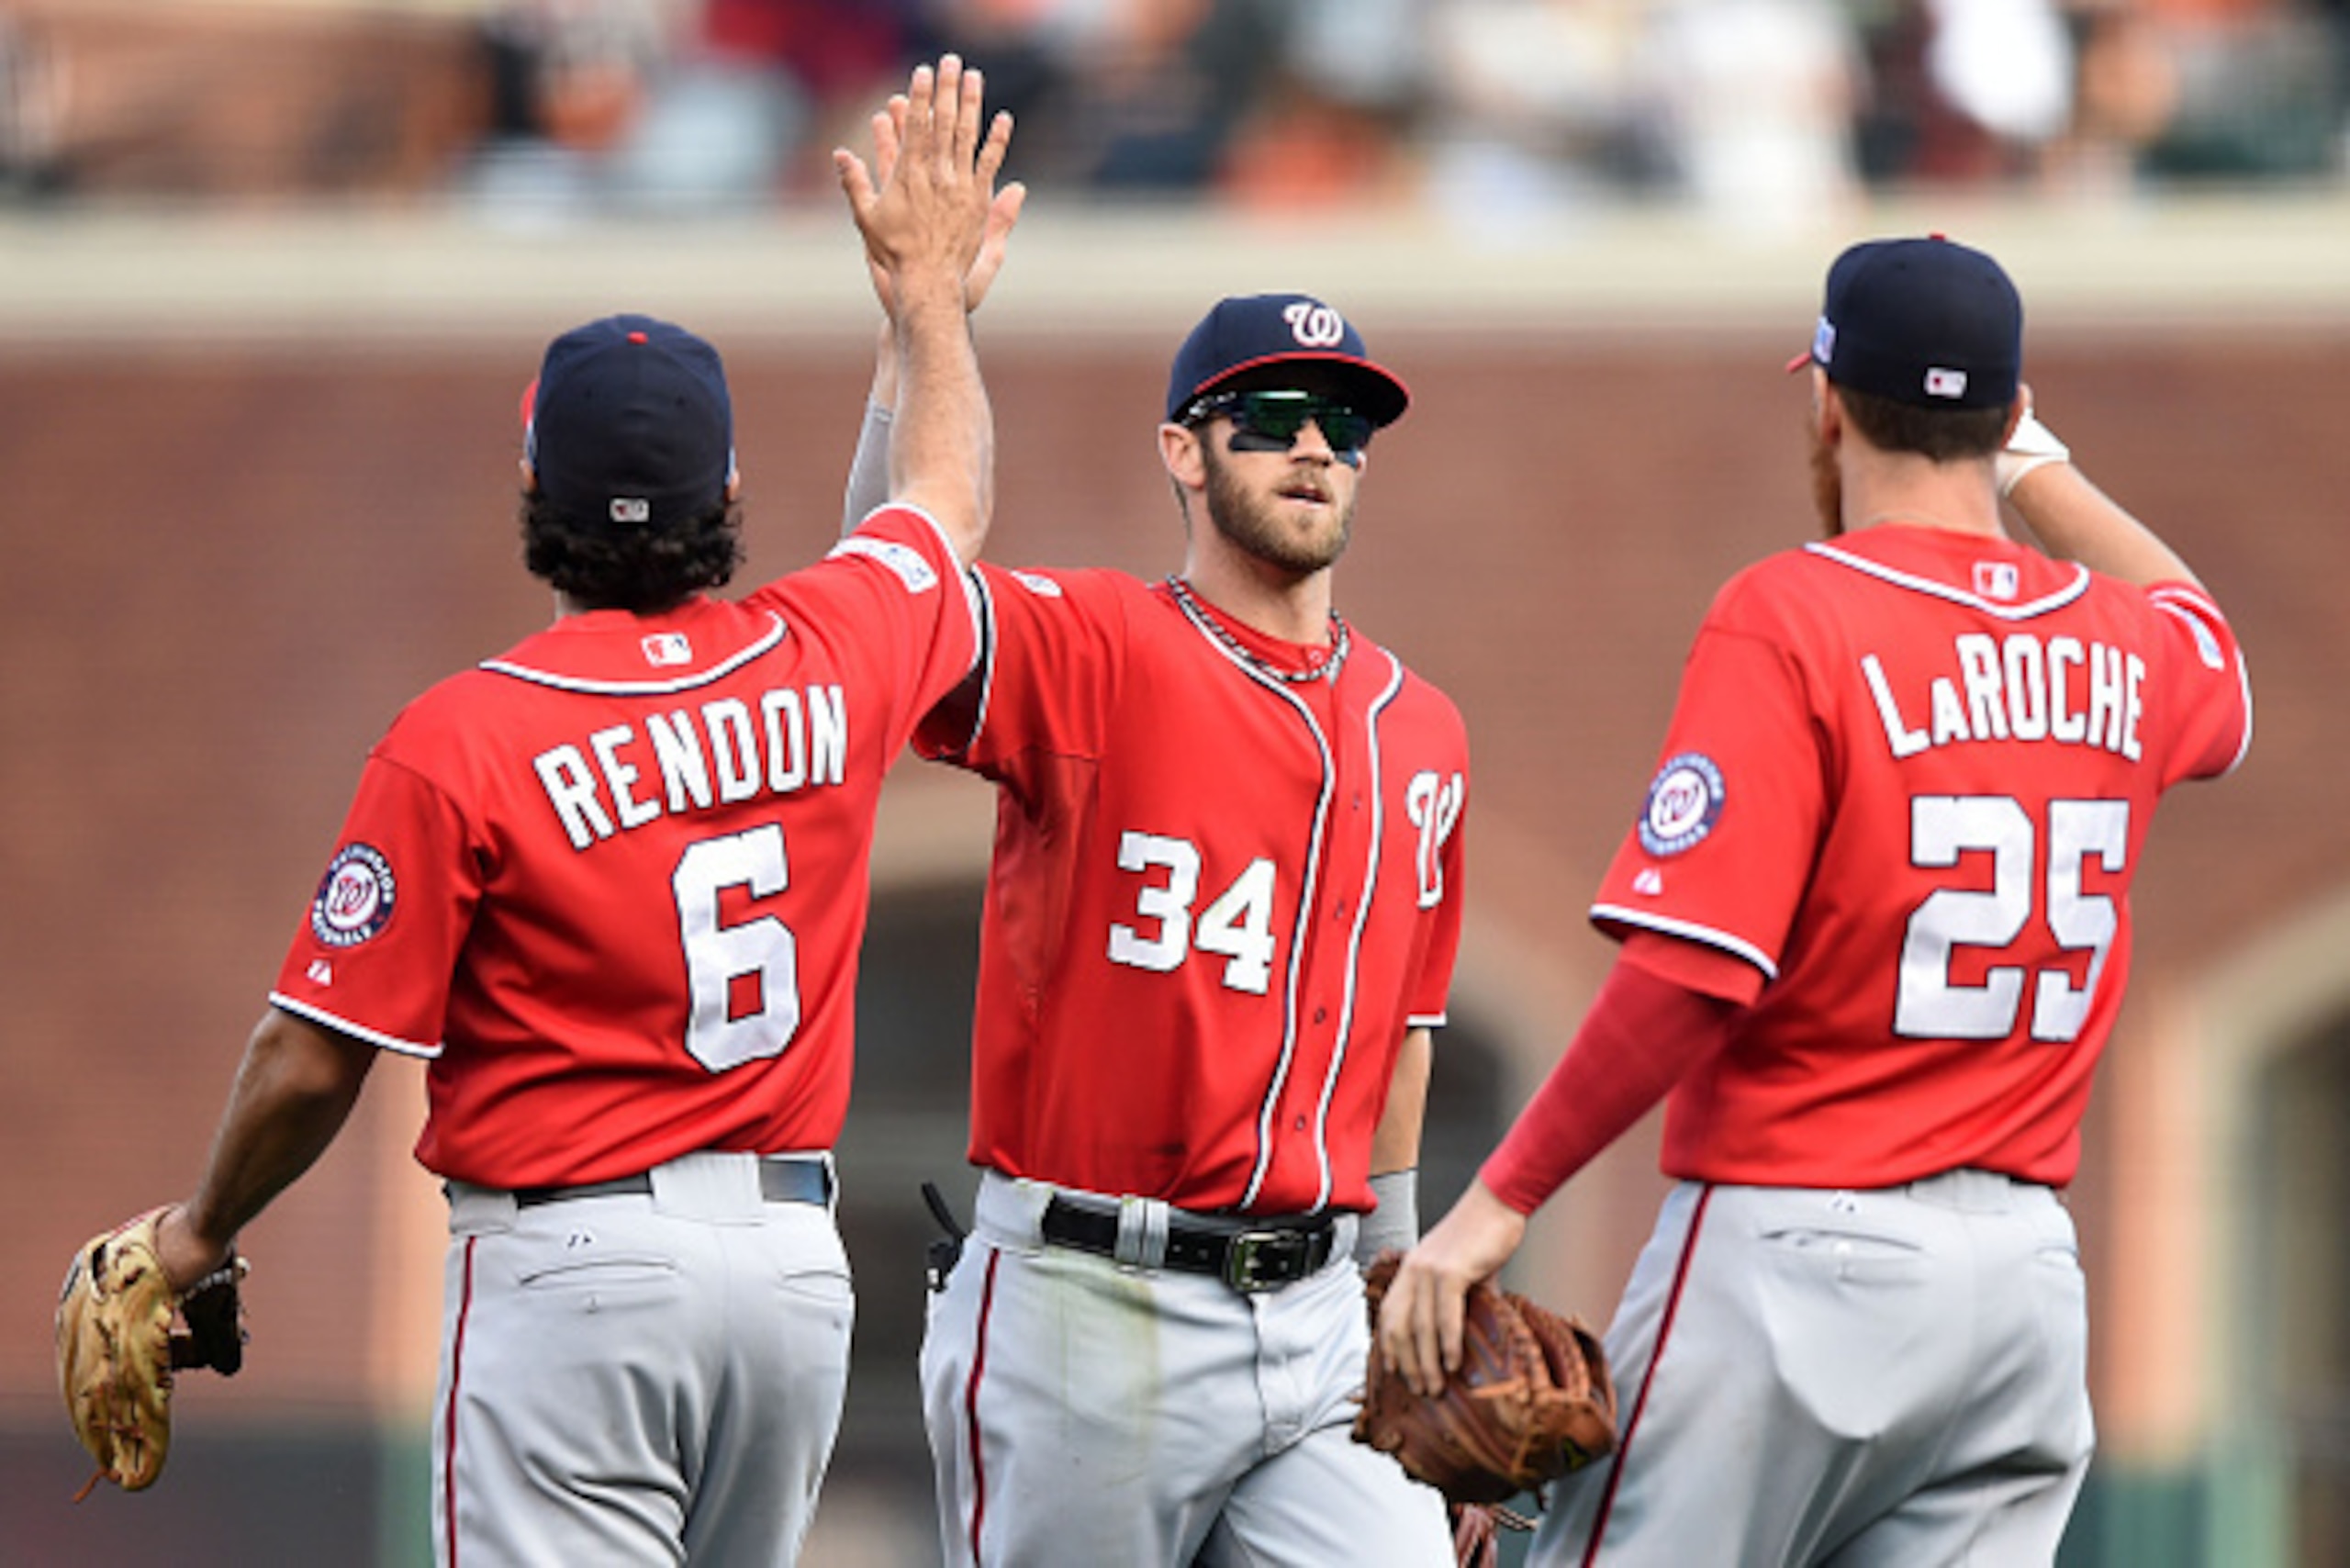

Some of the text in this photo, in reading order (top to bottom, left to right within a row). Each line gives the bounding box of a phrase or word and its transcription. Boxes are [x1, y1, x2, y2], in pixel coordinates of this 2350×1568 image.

[1283, 302, 1344, 348] W
[532, 684, 848, 852] RENDON
[670, 821, 801, 1074] 6
[1106, 829, 1278, 996] 34
[1892, 793, 2131, 1043] 25
